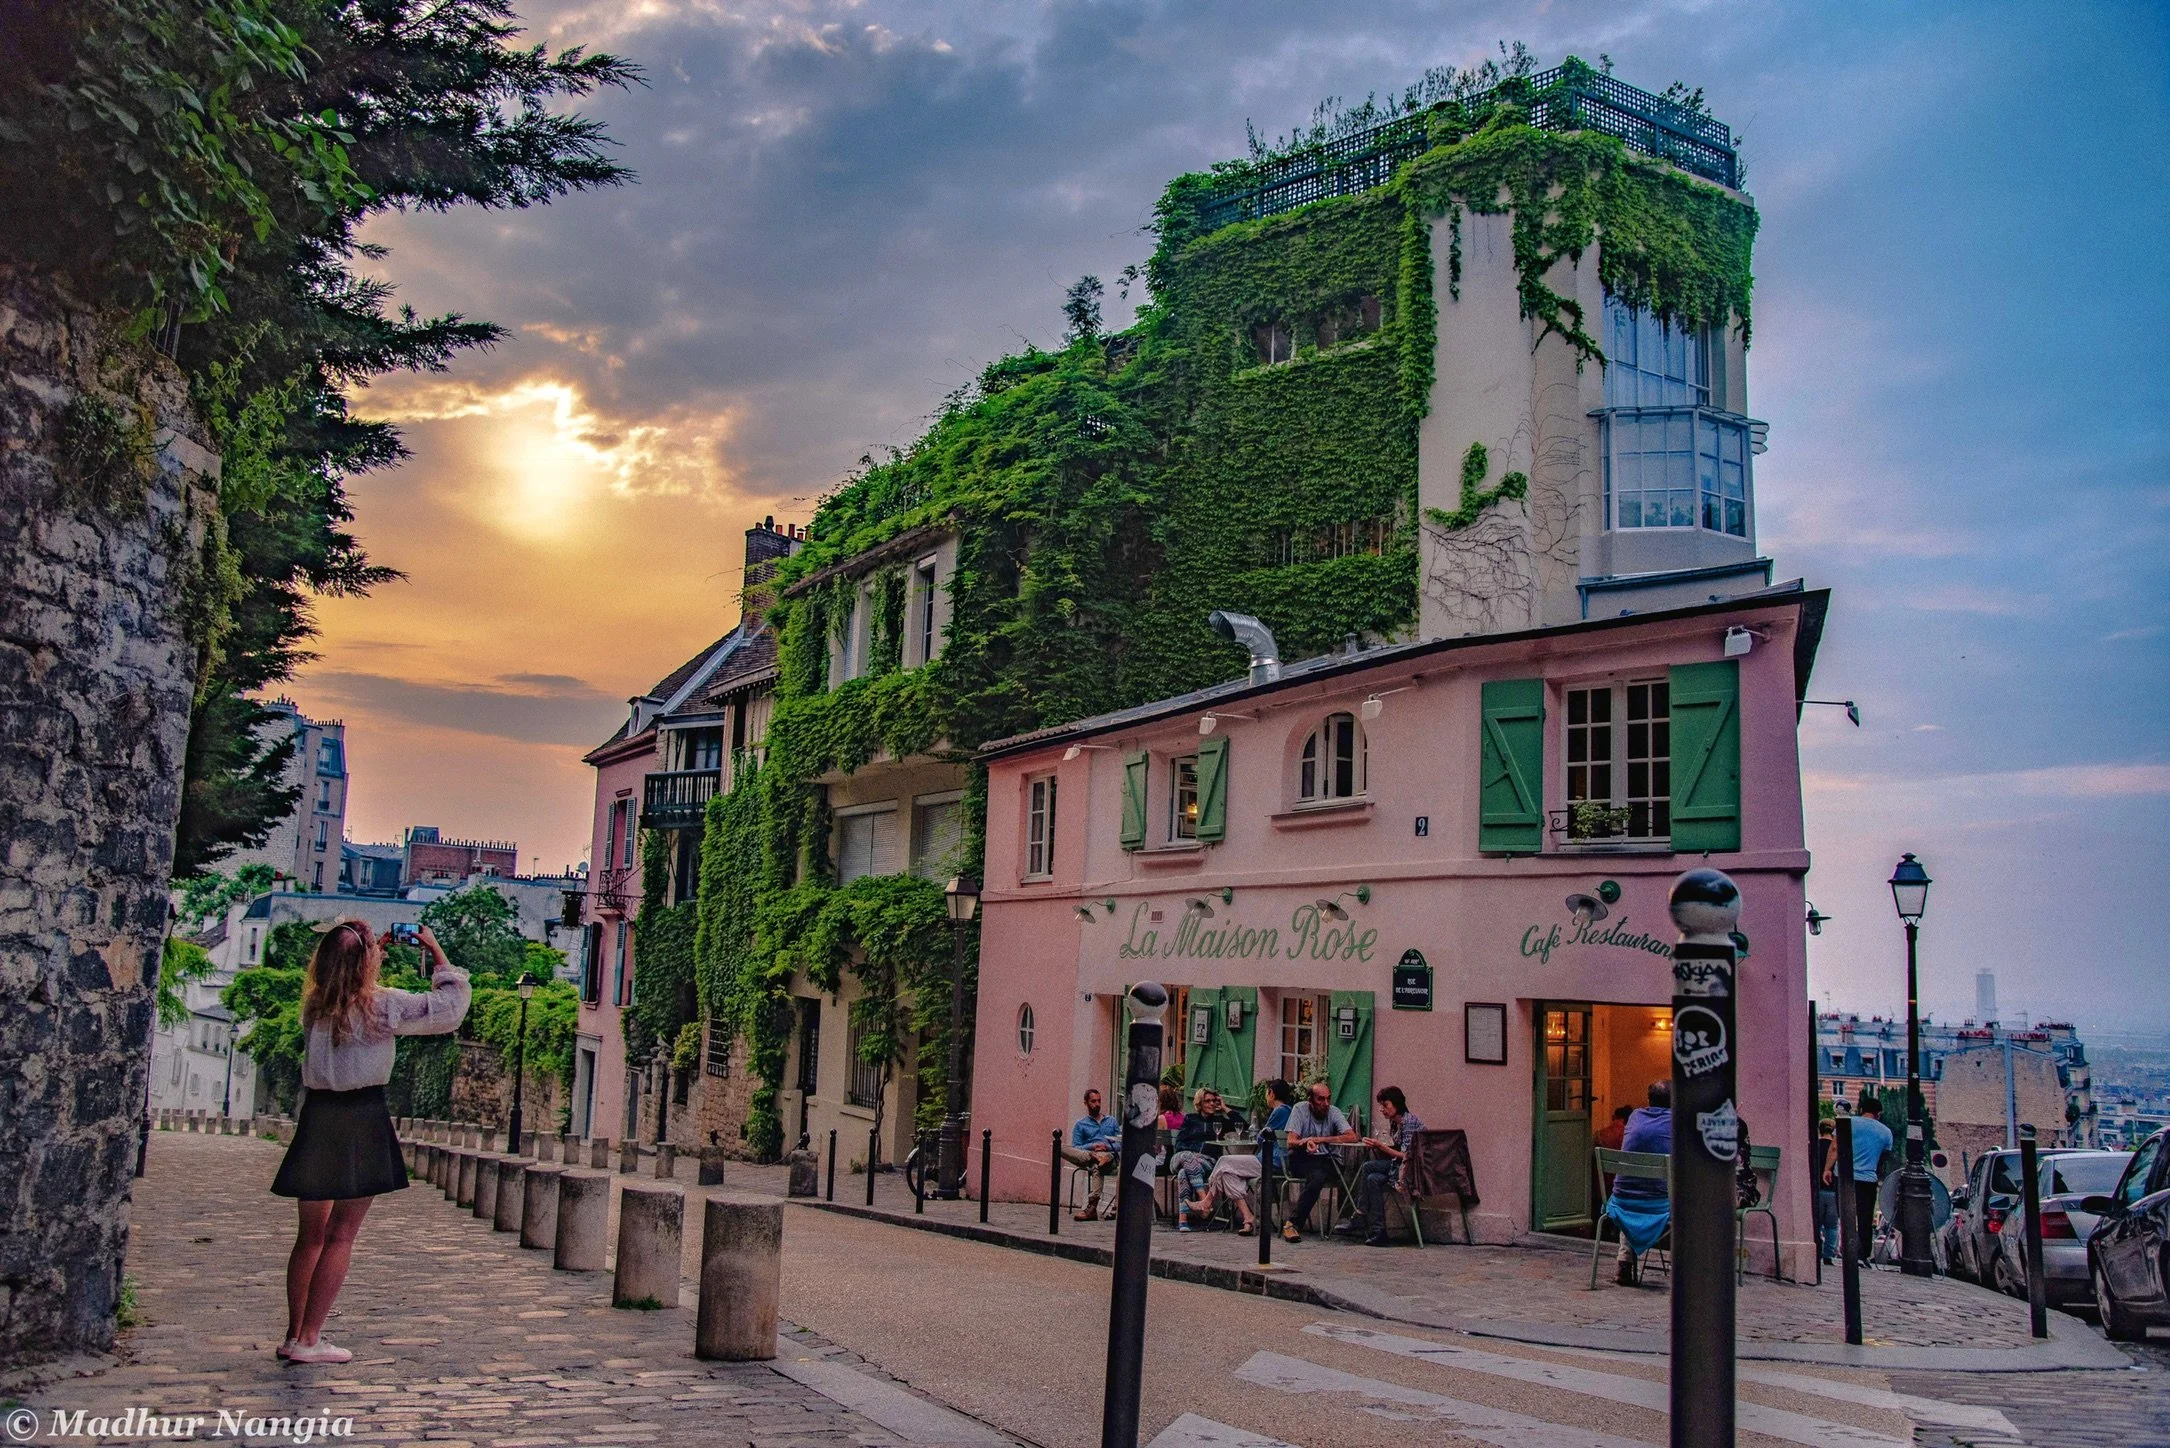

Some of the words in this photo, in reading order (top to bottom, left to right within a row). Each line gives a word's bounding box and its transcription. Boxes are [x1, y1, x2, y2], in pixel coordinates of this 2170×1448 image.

[1417, 817, 1426, 836] 2
[1119, 901, 1158, 959] La
[1161, 909, 1280, 960] Maison
[1287, 904, 1379, 963] Rose
[1519, 923, 1562, 965] Café
[1566, 915, 1674, 961] Restauran
